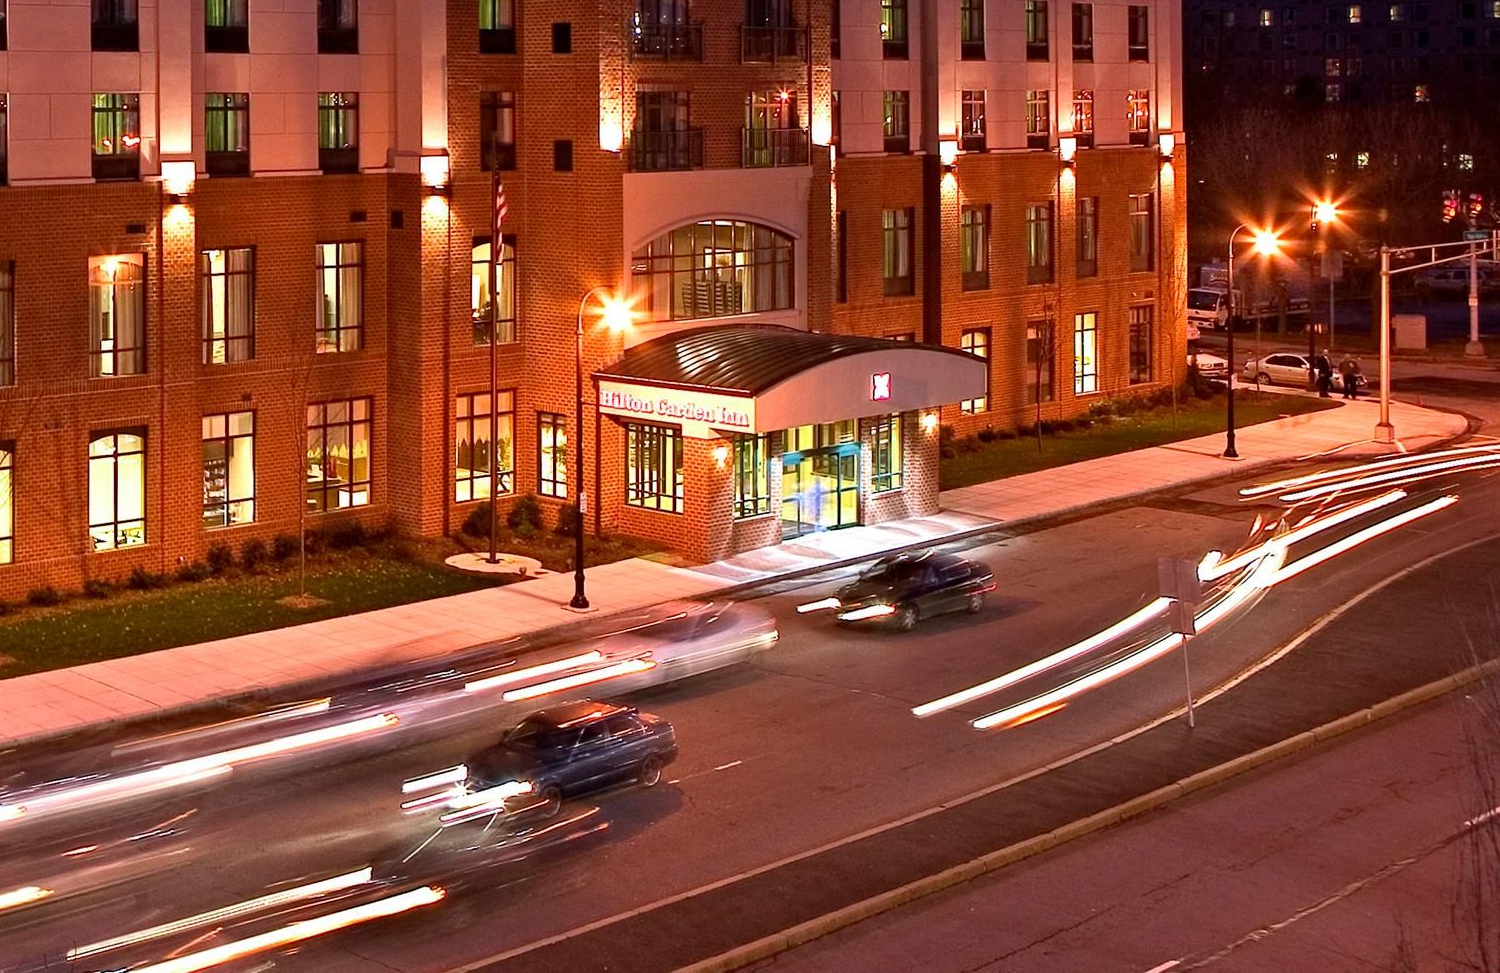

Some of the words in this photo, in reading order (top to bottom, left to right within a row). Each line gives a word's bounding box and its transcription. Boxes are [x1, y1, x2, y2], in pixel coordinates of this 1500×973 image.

[600, 389, 653, 414] Hilton
[658, 399, 715, 423] Garden
[718, 406, 750, 427] Inn
